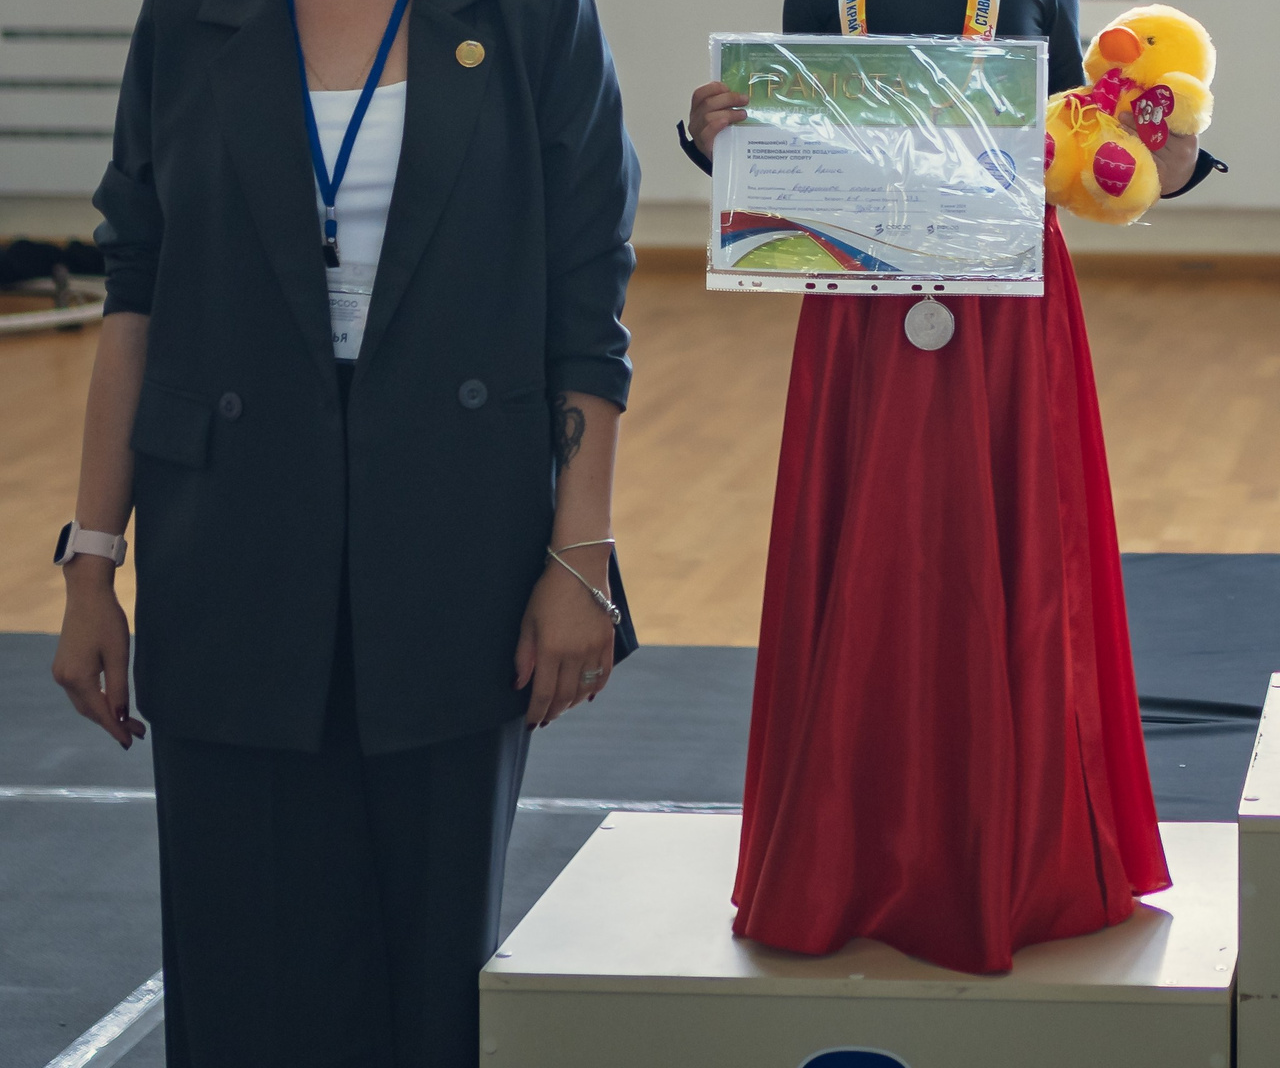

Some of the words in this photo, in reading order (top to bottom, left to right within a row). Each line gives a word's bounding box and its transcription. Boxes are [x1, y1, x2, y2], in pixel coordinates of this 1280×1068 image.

[846, 4, 861, 33] КРАЙ
[749, 72, 910, 99] ГРАМОТА
[330, 298, 359, 308] ФСОО
[332, 332, 348, 343] ЬЯ
